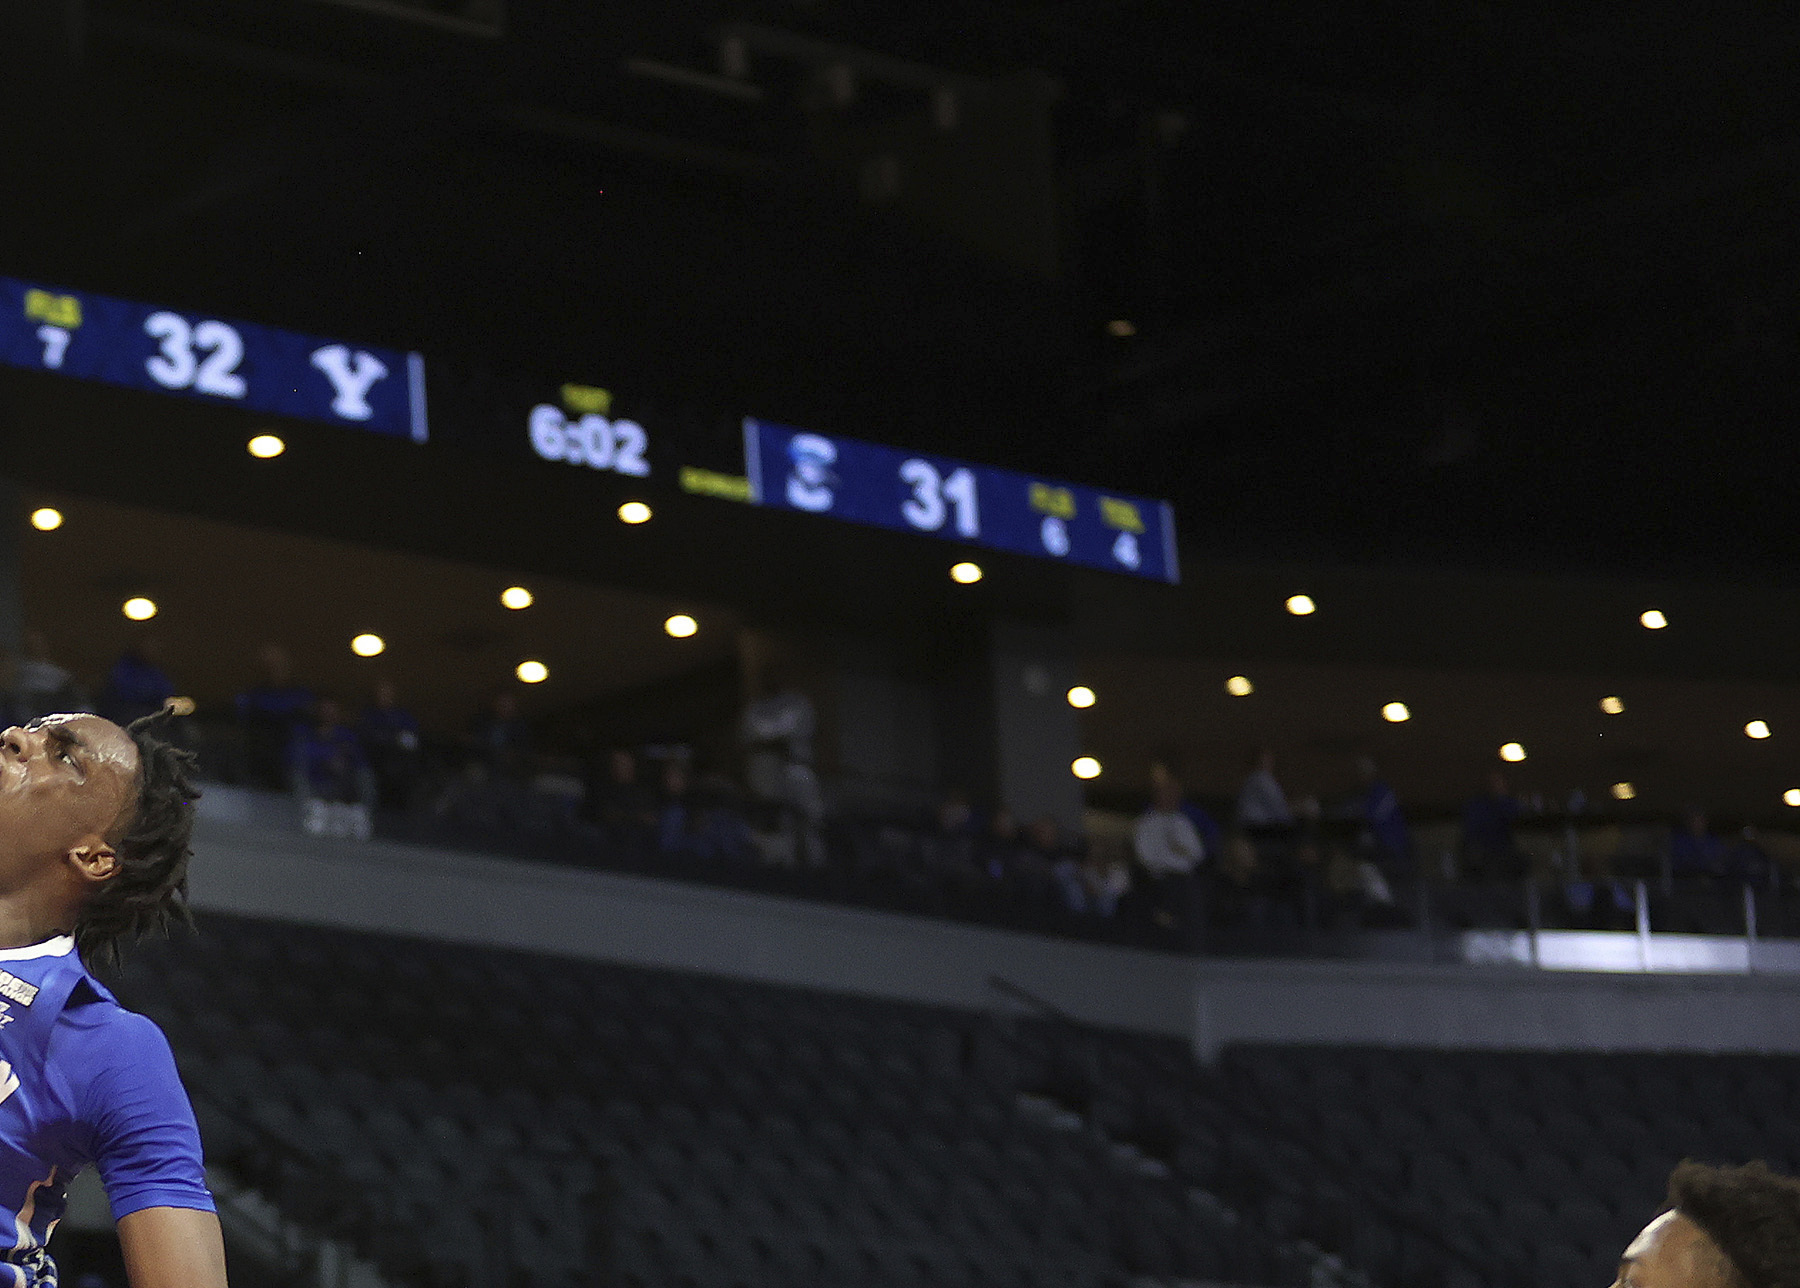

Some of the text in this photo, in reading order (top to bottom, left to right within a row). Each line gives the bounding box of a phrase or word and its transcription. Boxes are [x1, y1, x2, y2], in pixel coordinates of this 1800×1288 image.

[37, 325, 71, 368] 7
[143, 310, 248, 399] 32
[310, 344, 389, 421] Y
[528, 403, 650, 477] 6:02
[900, 458, 980, 539] 31
